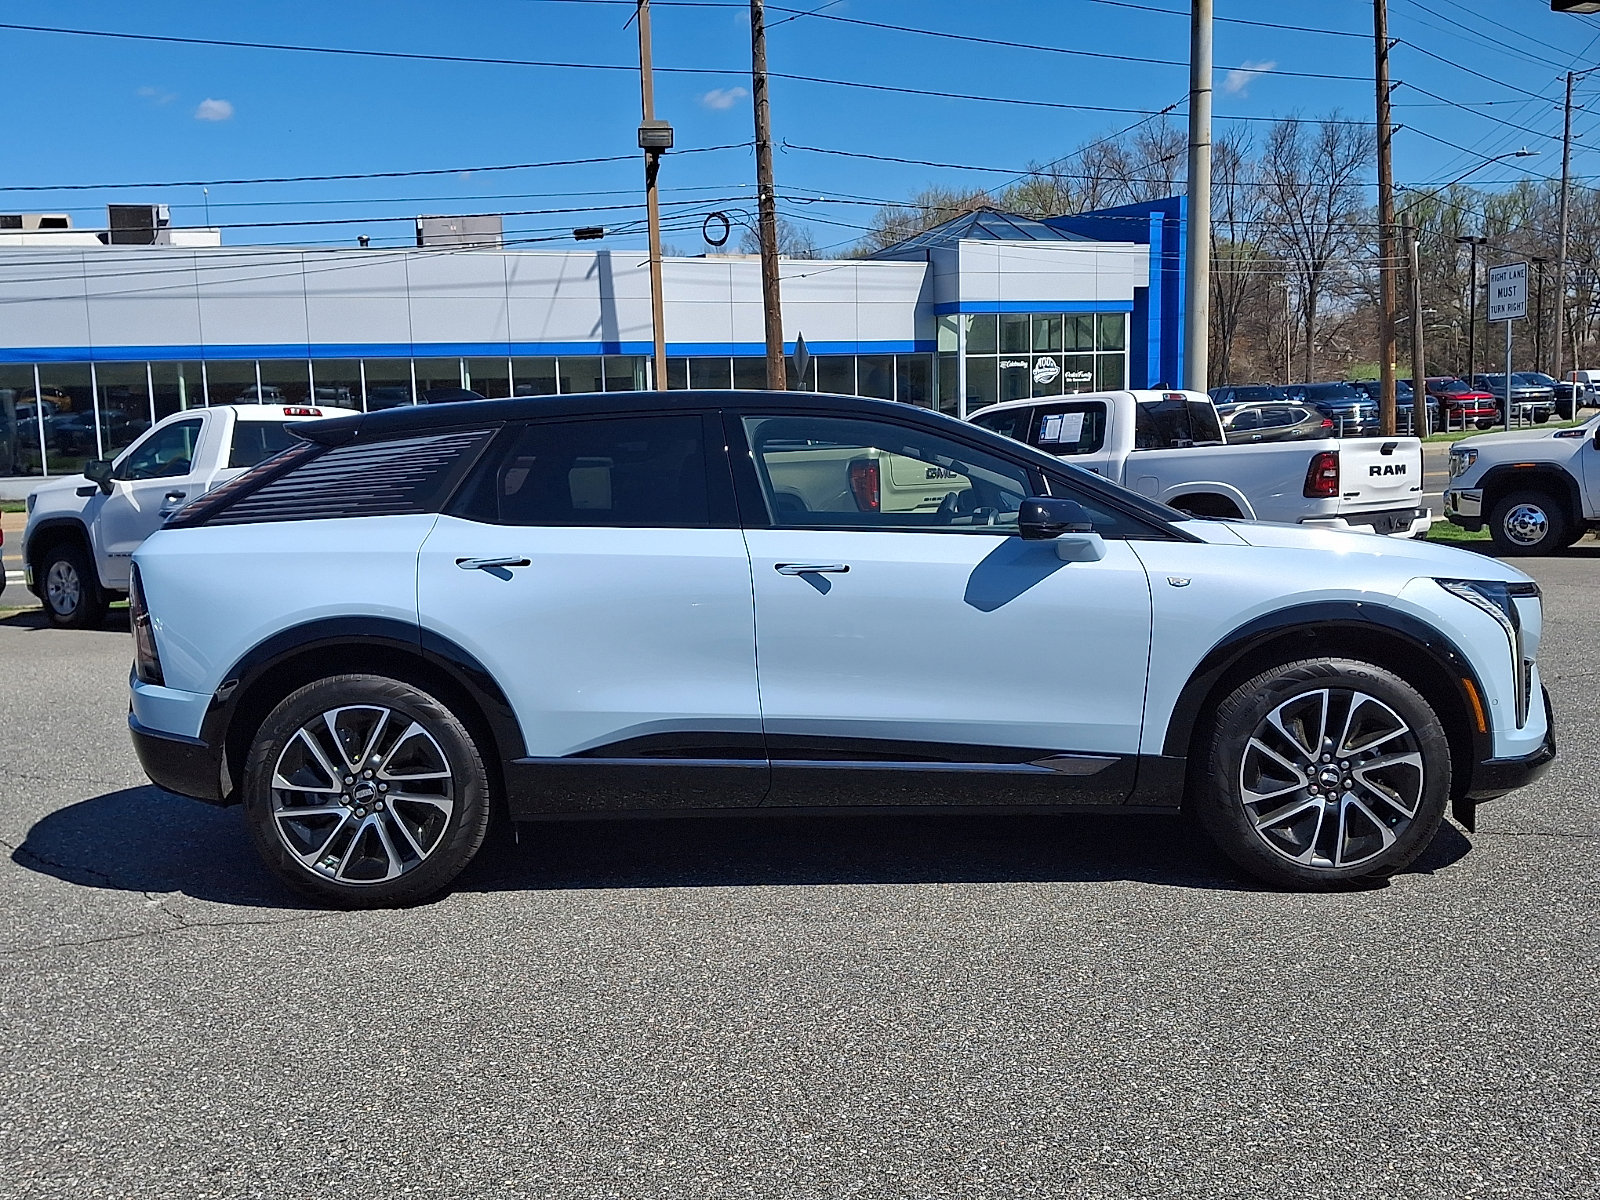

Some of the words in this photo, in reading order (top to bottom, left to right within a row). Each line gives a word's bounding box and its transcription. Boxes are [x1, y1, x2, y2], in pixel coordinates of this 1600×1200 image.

[1491, 272, 1507, 282] RIGHT
[1509, 269, 1524, 280] LANE
[1497, 286, 1517, 298] MUST
[1491, 304, 1505, 314] TURN
[1507, 302, 1524, 312] RIGHT
[926, 468, 957, 479] GMC
[1369, 464, 1406, 476] RAM
